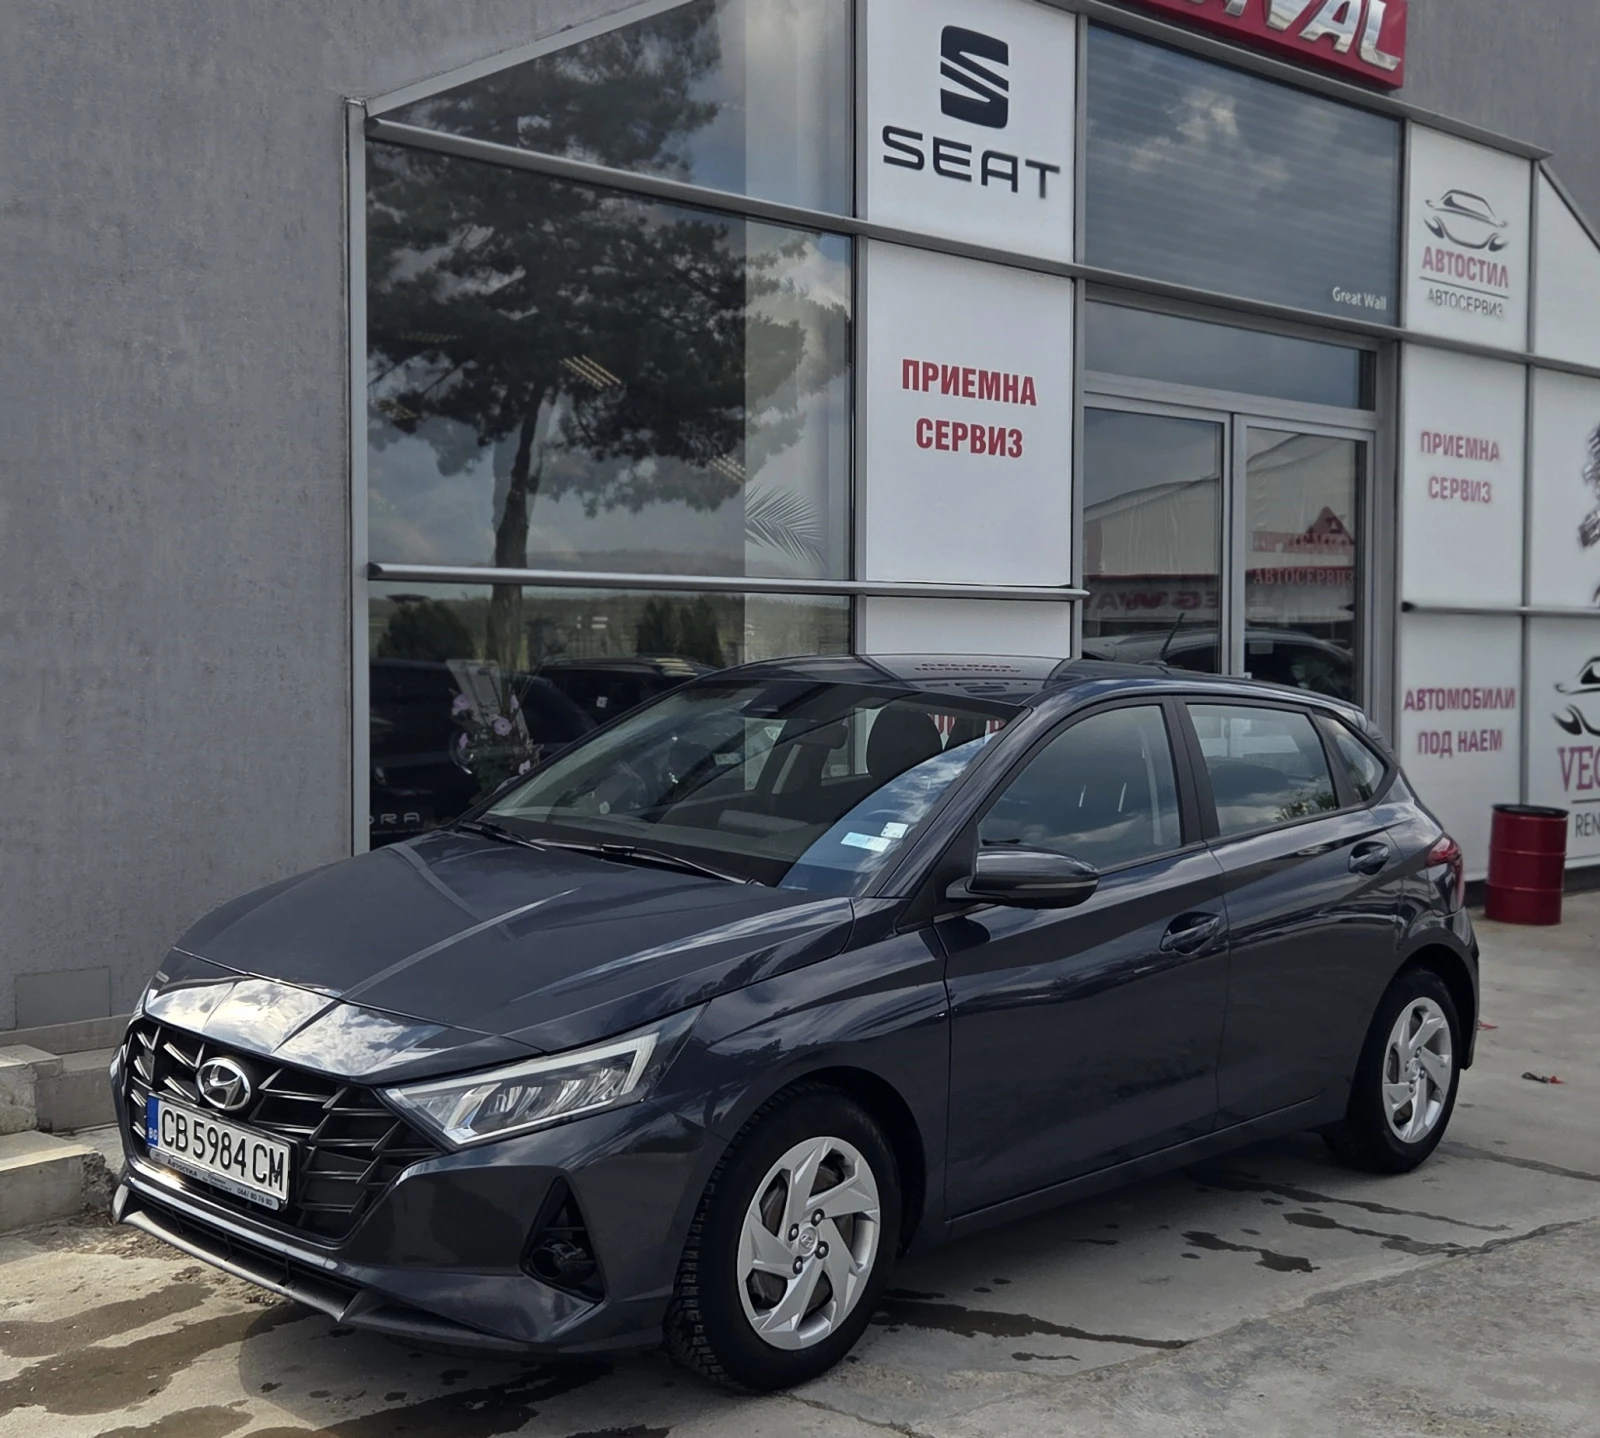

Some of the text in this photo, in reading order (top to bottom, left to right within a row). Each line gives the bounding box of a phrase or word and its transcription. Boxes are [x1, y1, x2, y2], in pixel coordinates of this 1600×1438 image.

[882, 125, 1060, 200] SEAT
[1422, 245, 1509, 289] АВТОСТИЛ
[1332, 286, 1387, 311] Great Wall
[1428, 287, 1503, 317] АВТОСЕРВИЗ
[902, 358, 1037, 406] ПРИЕМНА
[916, 417, 1023, 458] СЕРВИЗ
[1420, 430, 1500, 462] ПРИЕМНА
[1428, 475, 1492, 504] СЕРВИЗ
[1254, 567, 1355, 588] АВТОСЕРВИЗ
[1403, 687, 1516, 712] АВТОМОБИЛИ
[1418, 729, 1503, 758] ПОД НАЕМ
[148, 1127, 158, 1141] BG
[162, 1109, 284, 1192] CB 5984 CM
